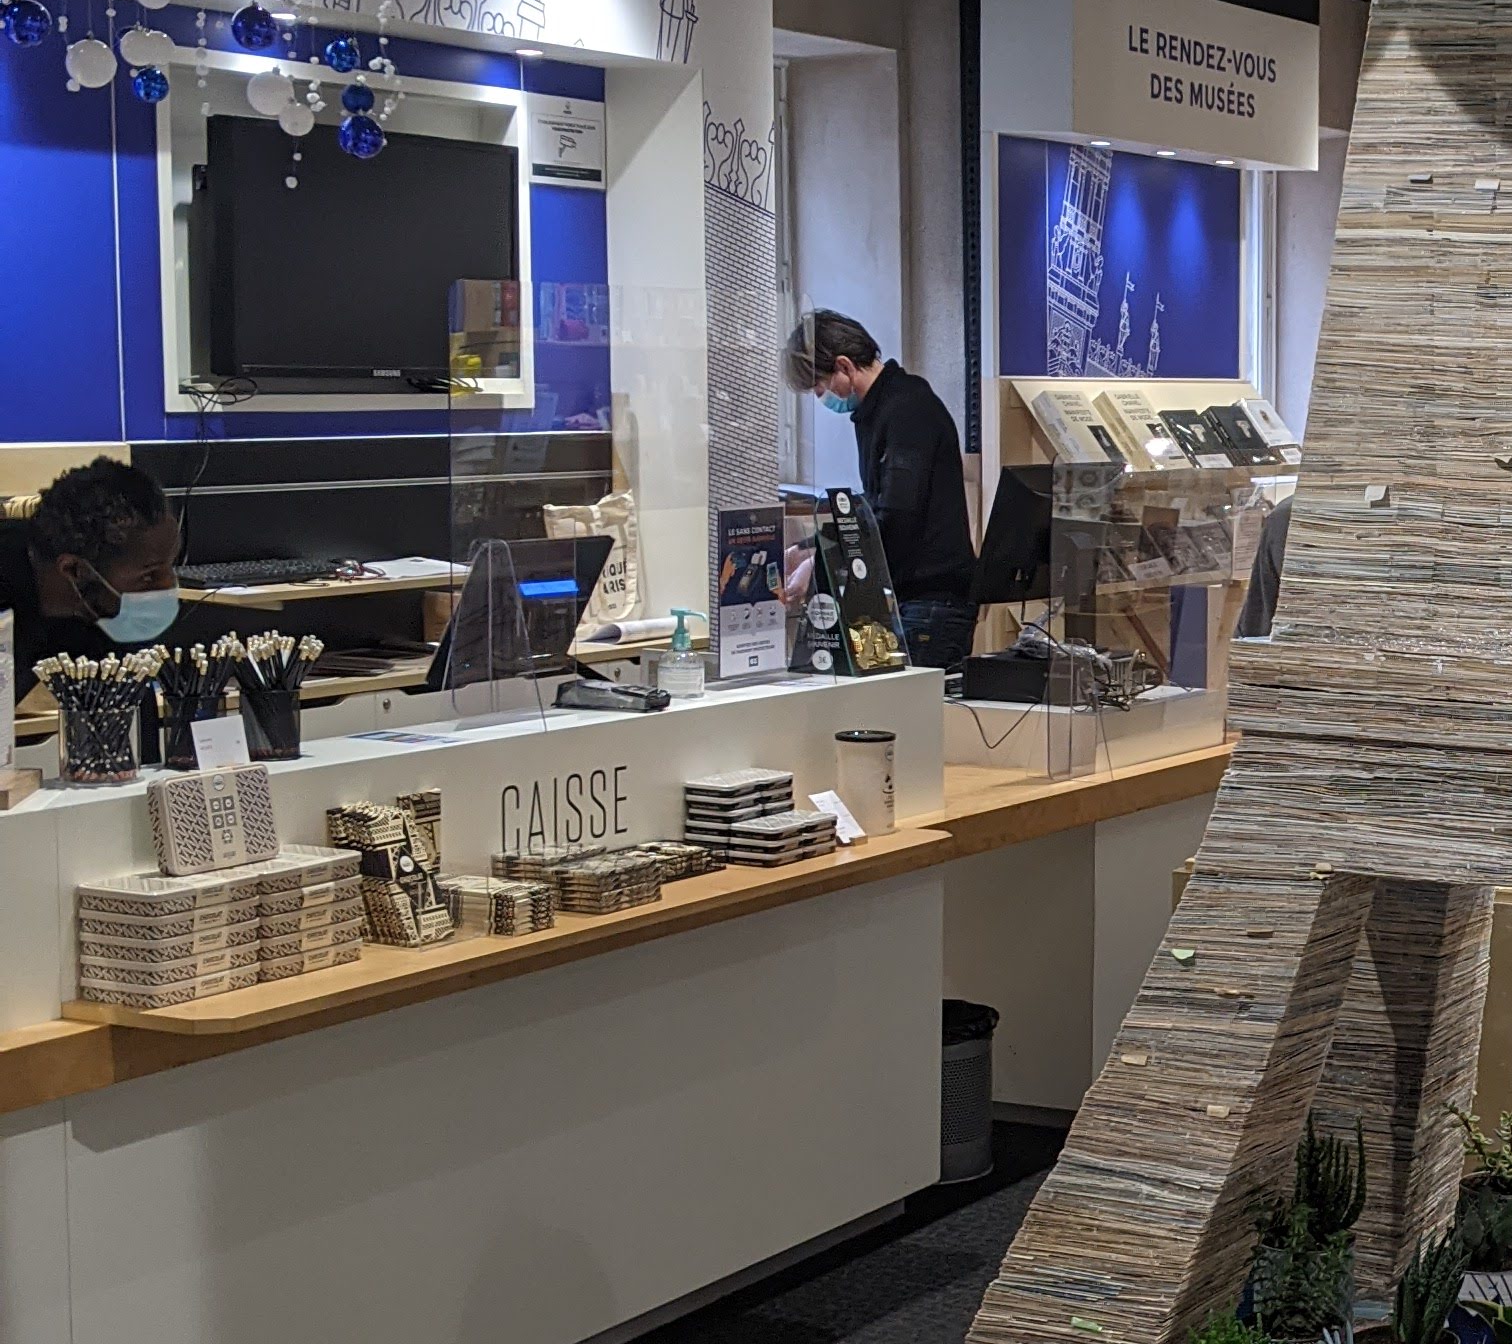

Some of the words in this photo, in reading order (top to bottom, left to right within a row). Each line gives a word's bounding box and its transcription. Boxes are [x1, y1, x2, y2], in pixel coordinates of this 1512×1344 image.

[1128, 24, 1150, 55] LE
[1156, 31, 1277, 83] RENDEZ-VOUS
[1150, 72, 1184, 105] DES
[1190, 81, 1256, 119] MUSÉES
[501, 765, 628, 857] CAISSE
